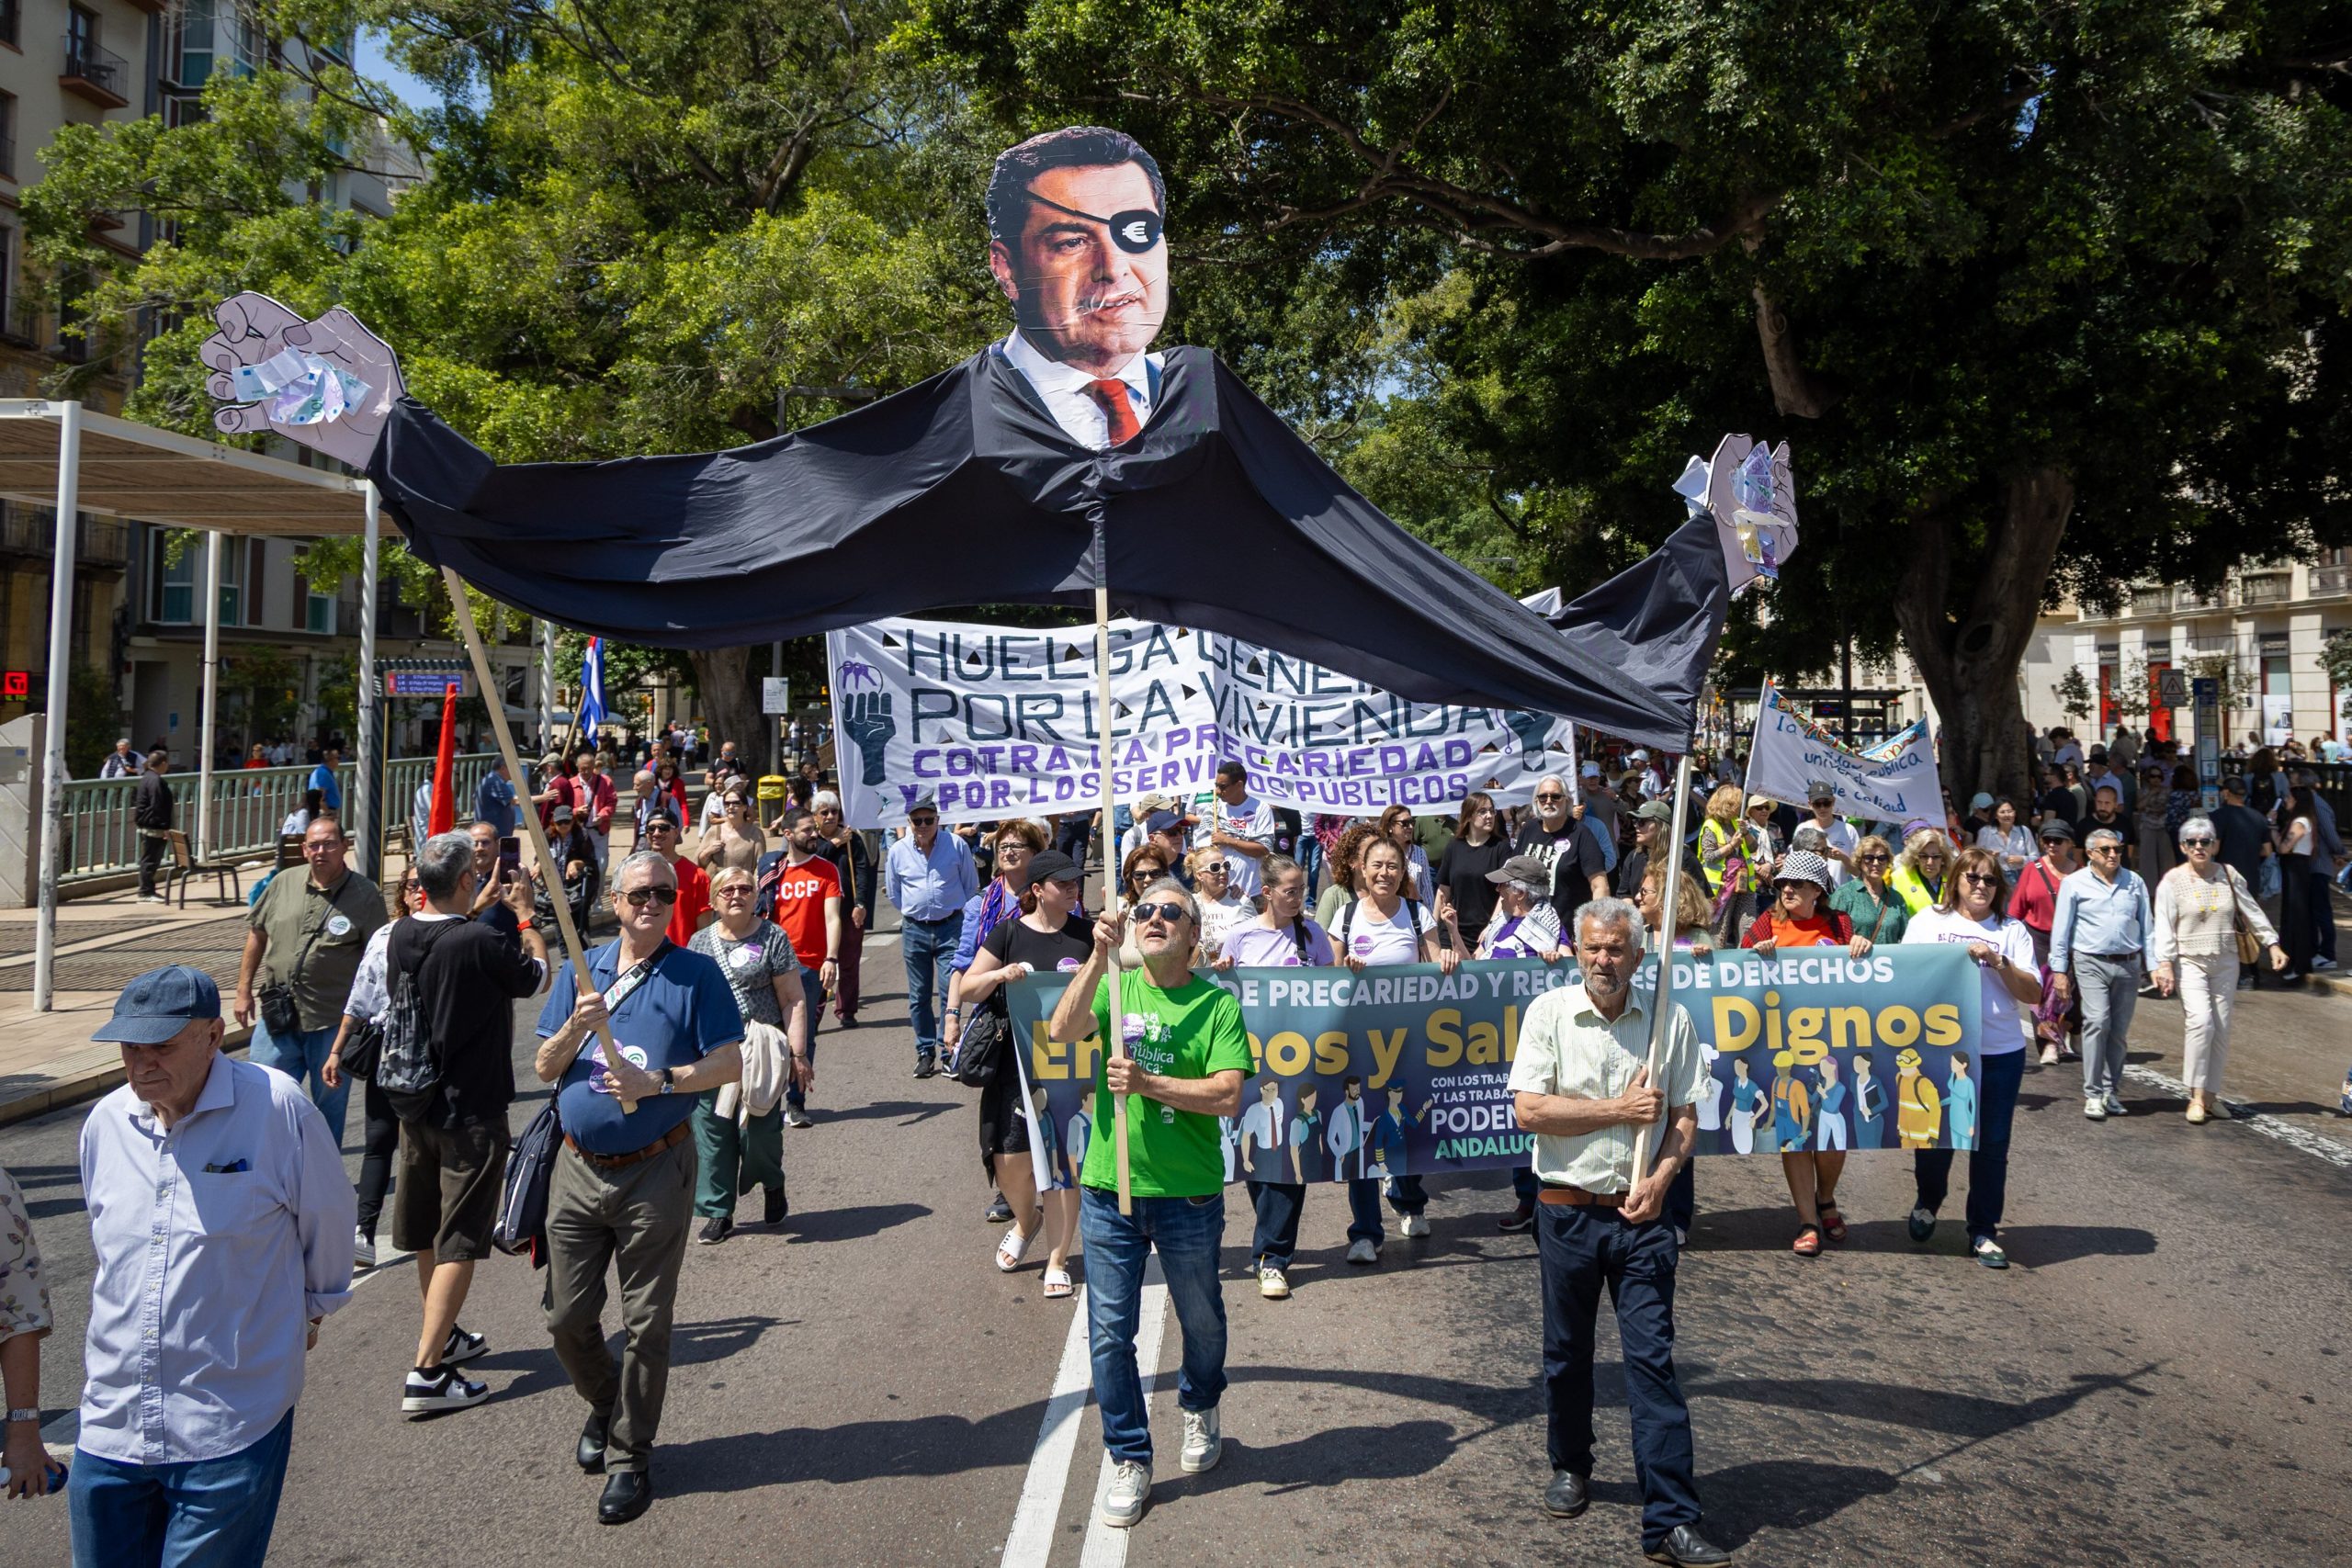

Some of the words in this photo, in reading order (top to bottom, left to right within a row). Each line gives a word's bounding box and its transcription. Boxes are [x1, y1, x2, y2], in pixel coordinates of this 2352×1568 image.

[906, 624, 1179, 682] HUELGA
[1197, 629, 1366, 695] GENE
[910, 688, 1065, 745] POR
[1082, 679, 1181, 739] LA
[1198, 671, 1496, 750] VIVIENDA
[913, 744, 1071, 779] CONTRA
[1091, 739, 1148, 770] LA
[1166, 723, 1473, 777] PRECARIEDAD
[938, 779, 1011, 812] POR
[1029, 772, 1101, 805] LOS
[1112, 750, 1289, 798] SERVIOS
[1295, 773, 1469, 807] PÚBLICOS
[1217, 979, 1259, 1007] DE
[1269, 973, 1479, 1008] PRECARIEDAD
[1487, 971, 1506, 998] Y
[1512, 964, 1657, 997] RECES
[1671, 962, 1712, 990] DE
[1719, 956, 1894, 988] DERECHOS
[1366, 1028, 1408, 1090] y
[1712, 990, 1963, 1066] Dignos
[1431, 1077, 1455, 1089] CON
[1457, 1075, 1479, 1087] LOS
[1431, 1093, 1441, 1104] Y
[1443, 1090, 1466, 1103] LAS
